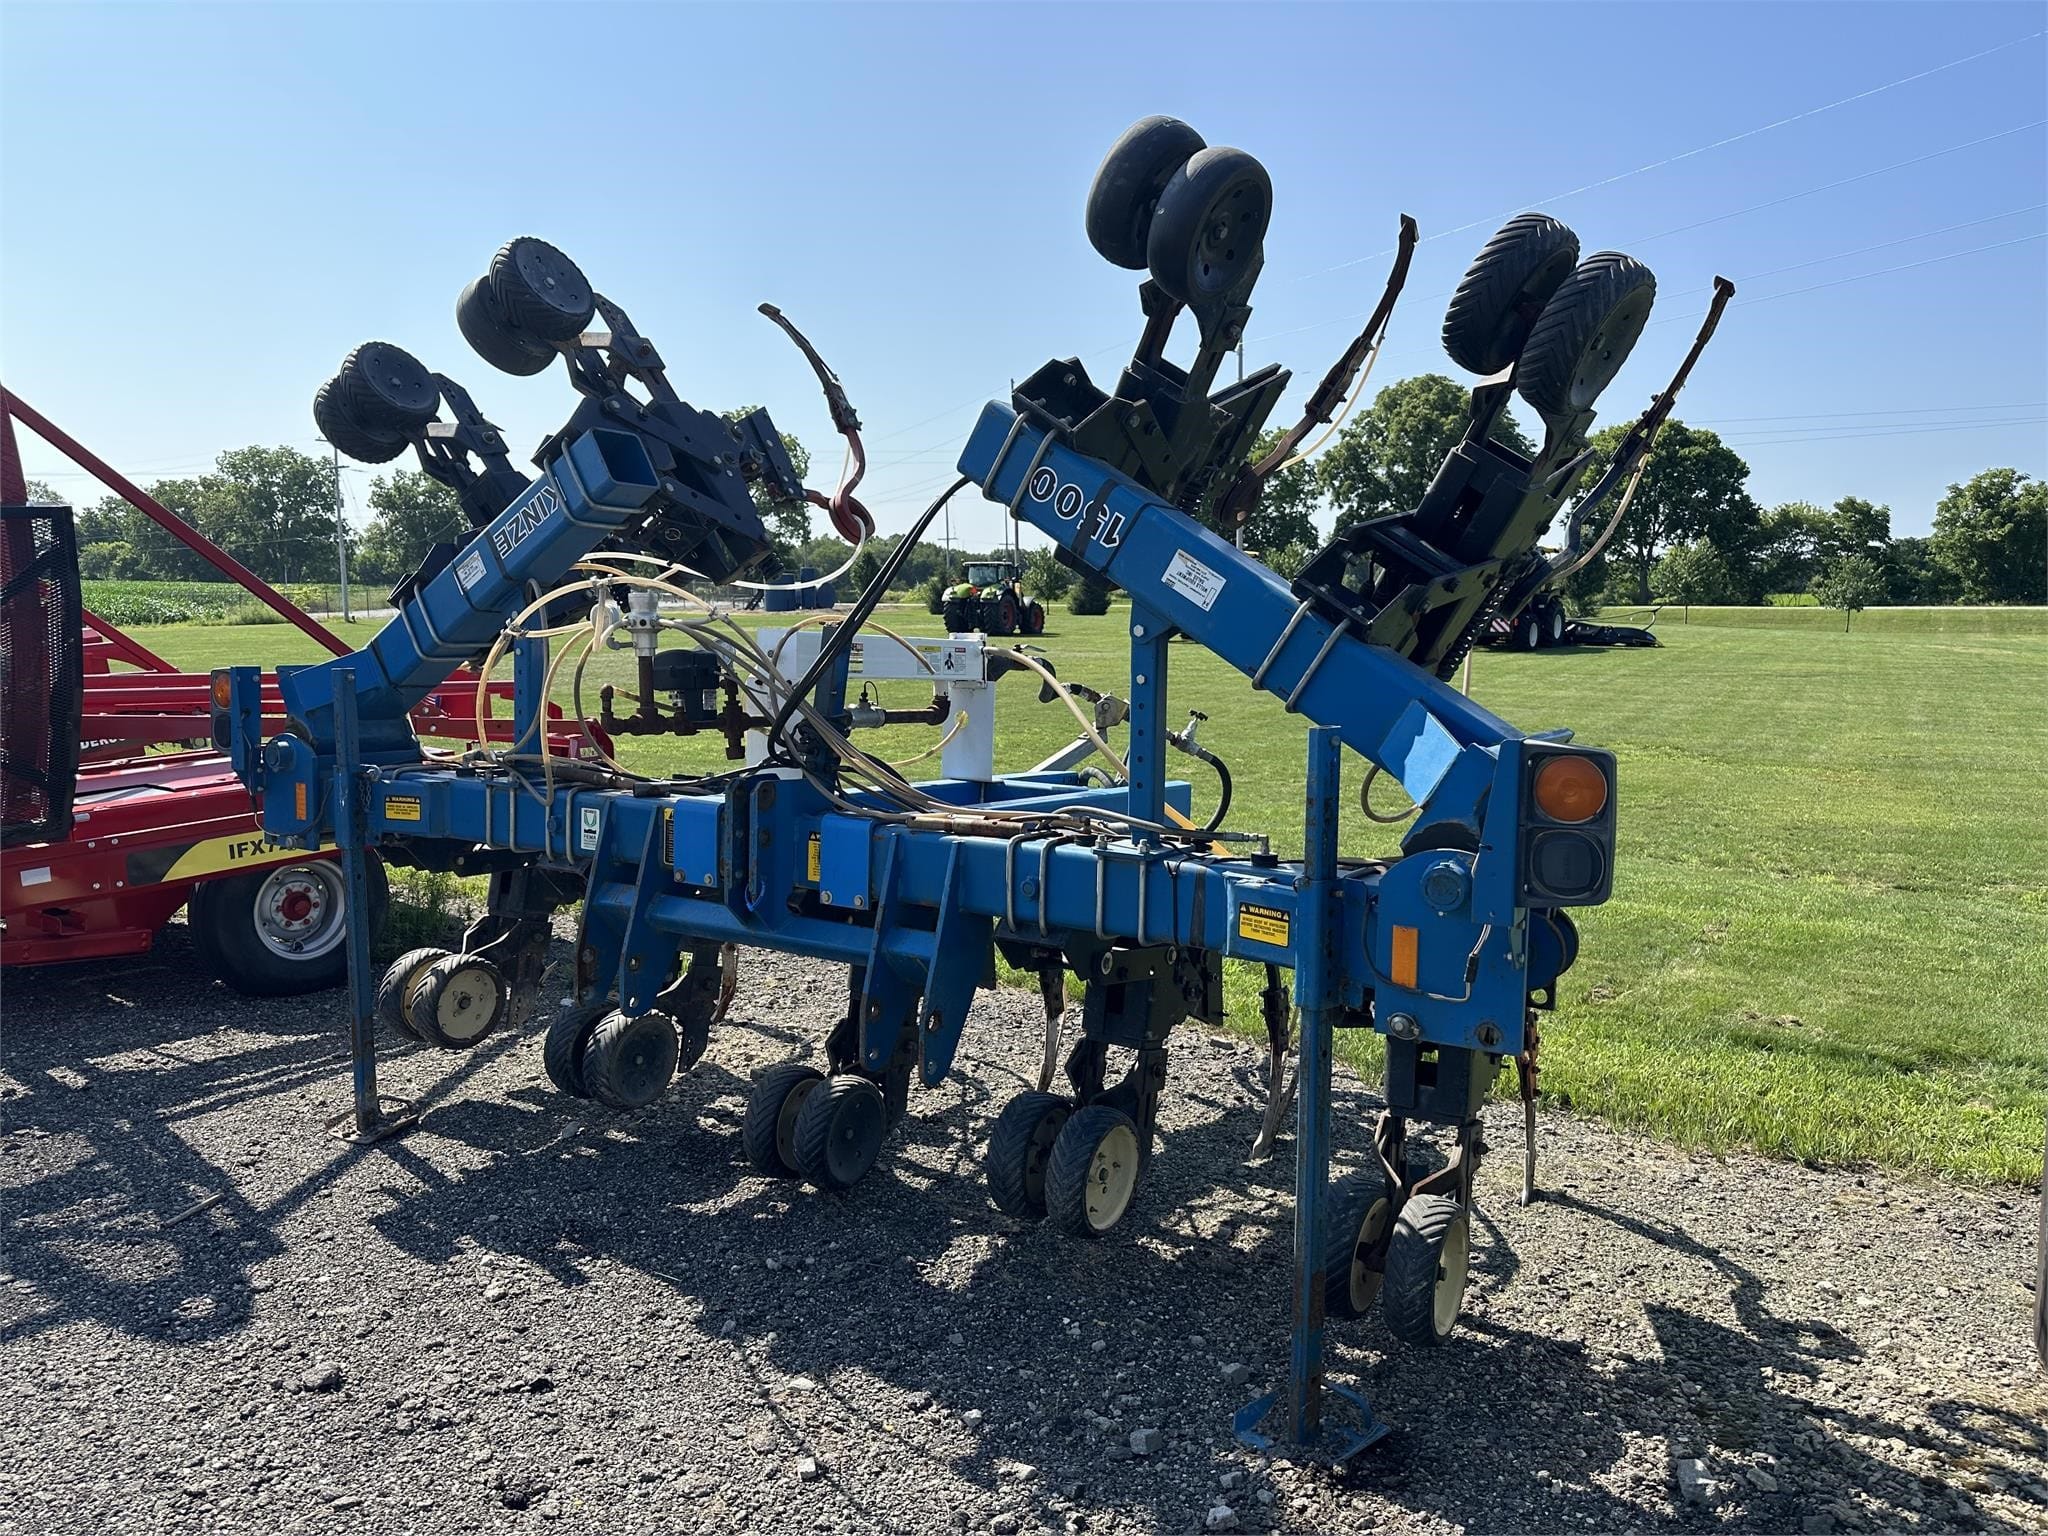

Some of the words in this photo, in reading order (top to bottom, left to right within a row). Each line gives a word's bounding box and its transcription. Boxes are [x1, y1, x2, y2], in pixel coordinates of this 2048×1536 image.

[493, 477, 566, 560] KINZE
[1029, 466, 1125, 548] 1500
[1248, 905, 1282, 918] WARNING
